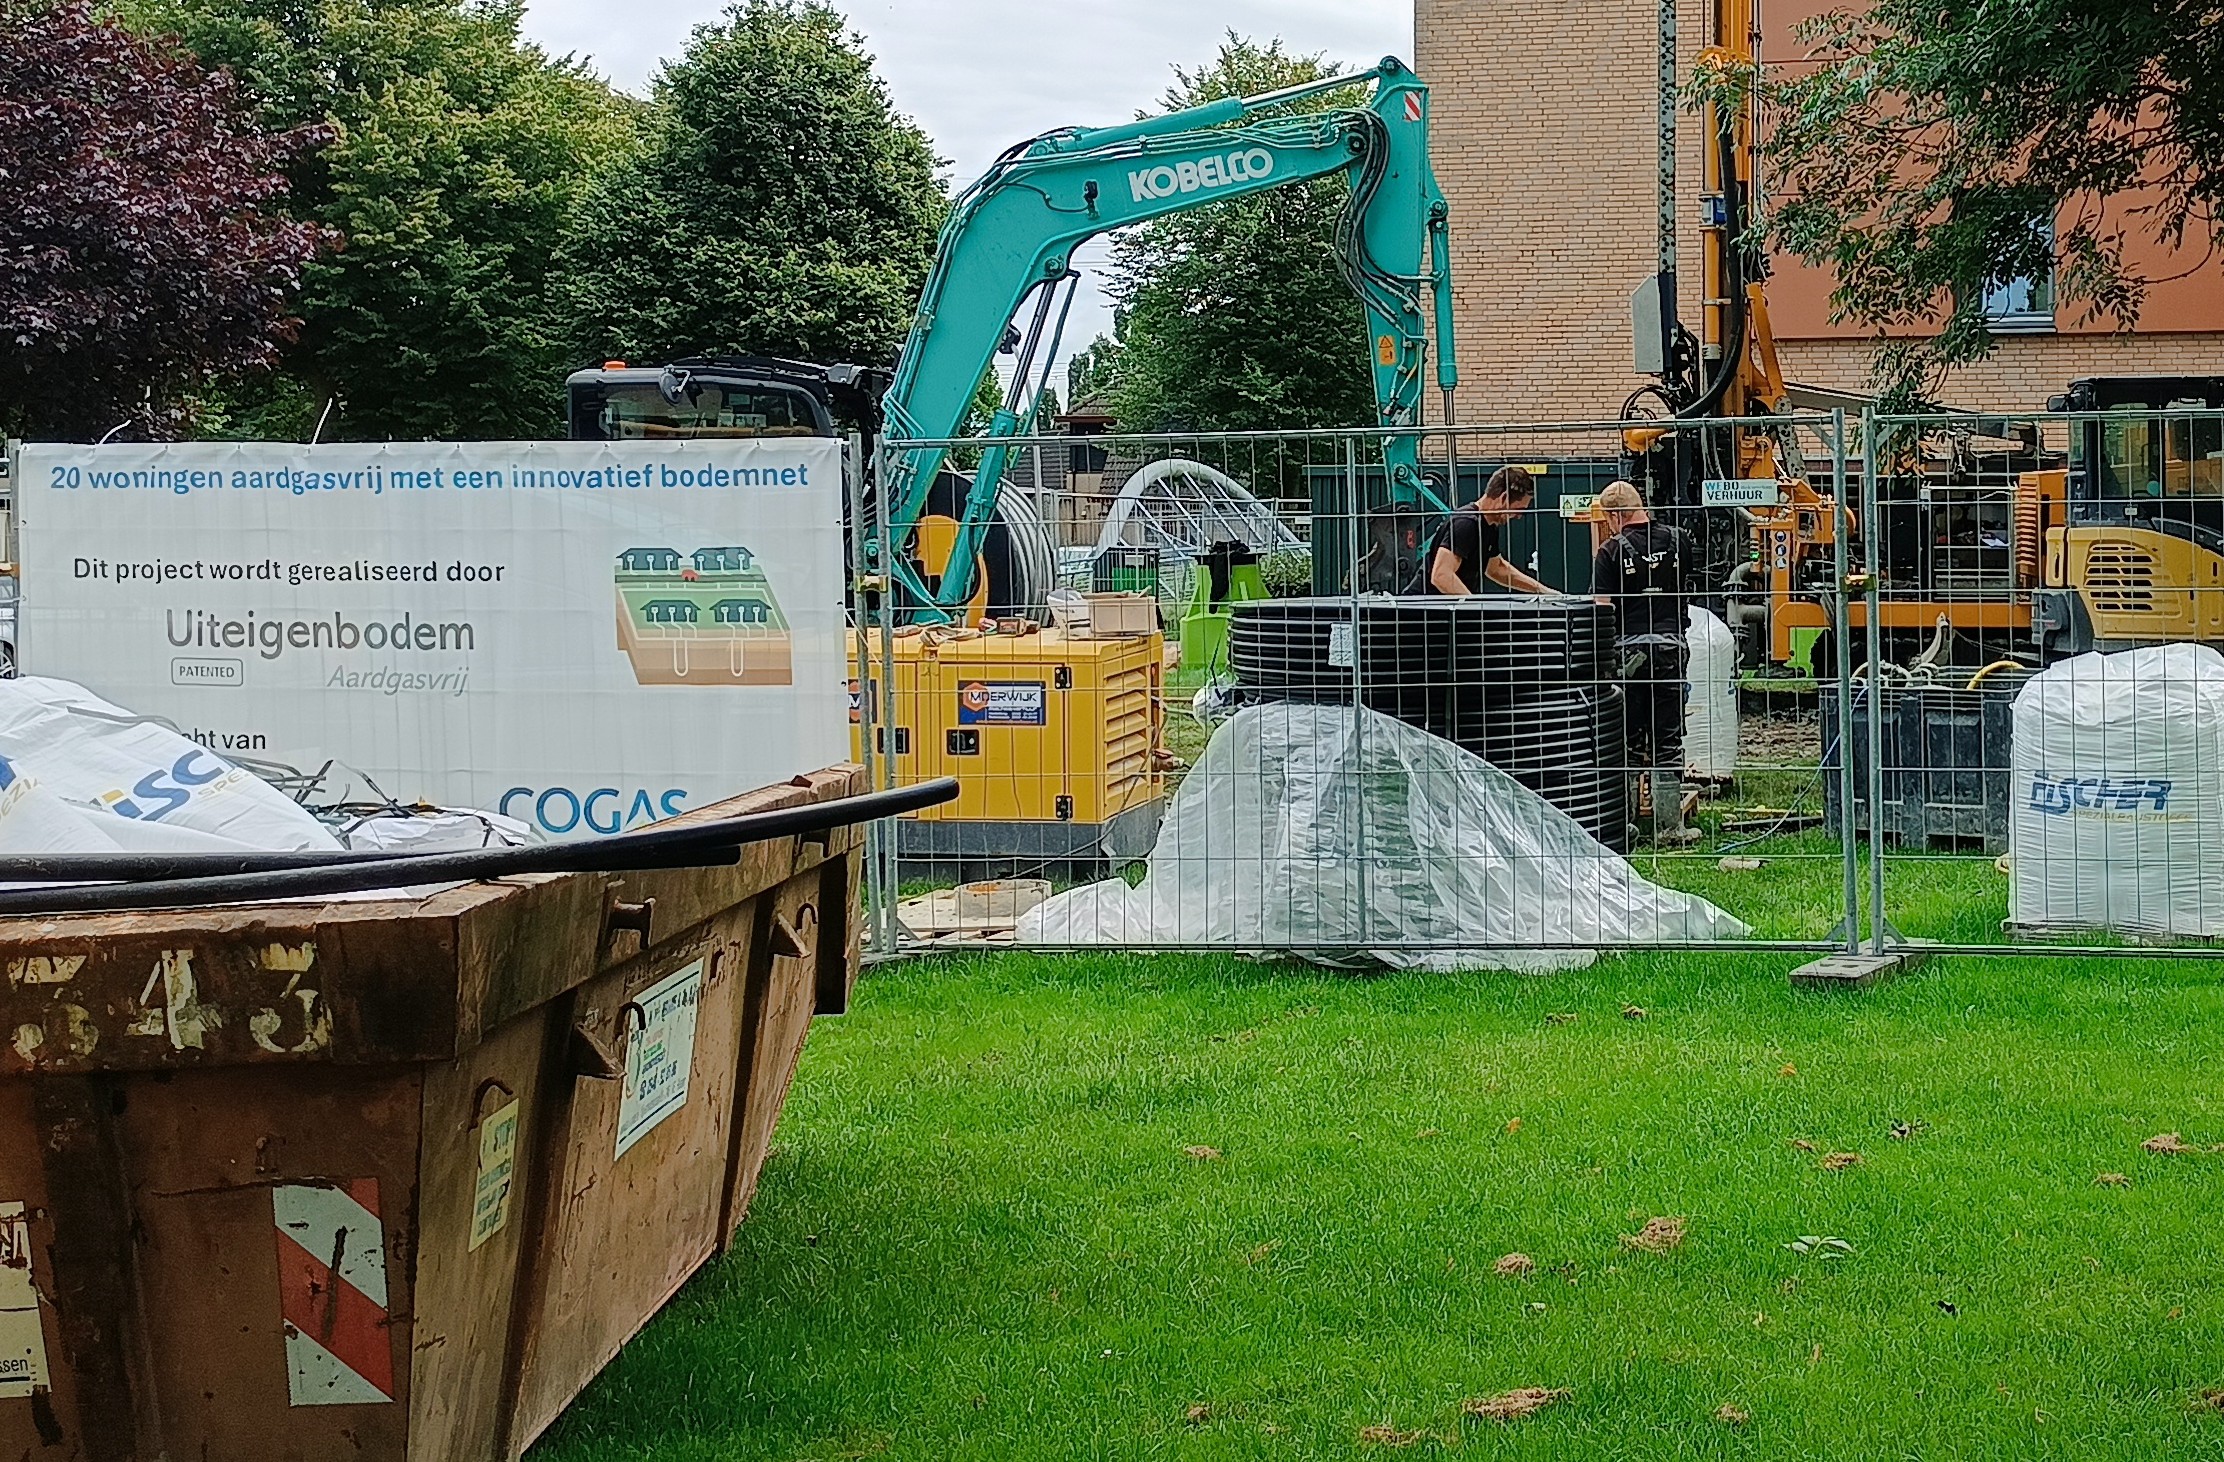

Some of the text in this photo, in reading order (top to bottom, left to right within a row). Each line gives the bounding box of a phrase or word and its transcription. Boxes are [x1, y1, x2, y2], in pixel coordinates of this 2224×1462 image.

[1128, 148, 1273, 202] KOBELCO
[51, 462, 809, 495] 20 woningen aardgasvrij met een innovatief bodemnet
[1707, 490, 1763, 501] VERHUUR
[73, 557, 506, 585] Dit project wordt gerealiseerd door
[166, 608, 475, 660] Uiteigenbodem
[179, 664, 235, 679] PATENTED
[327, 664, 470, 697] Aardgasvrij
[222, 733, 267, 749] van
[499, 787, 688, 835] COGAS
